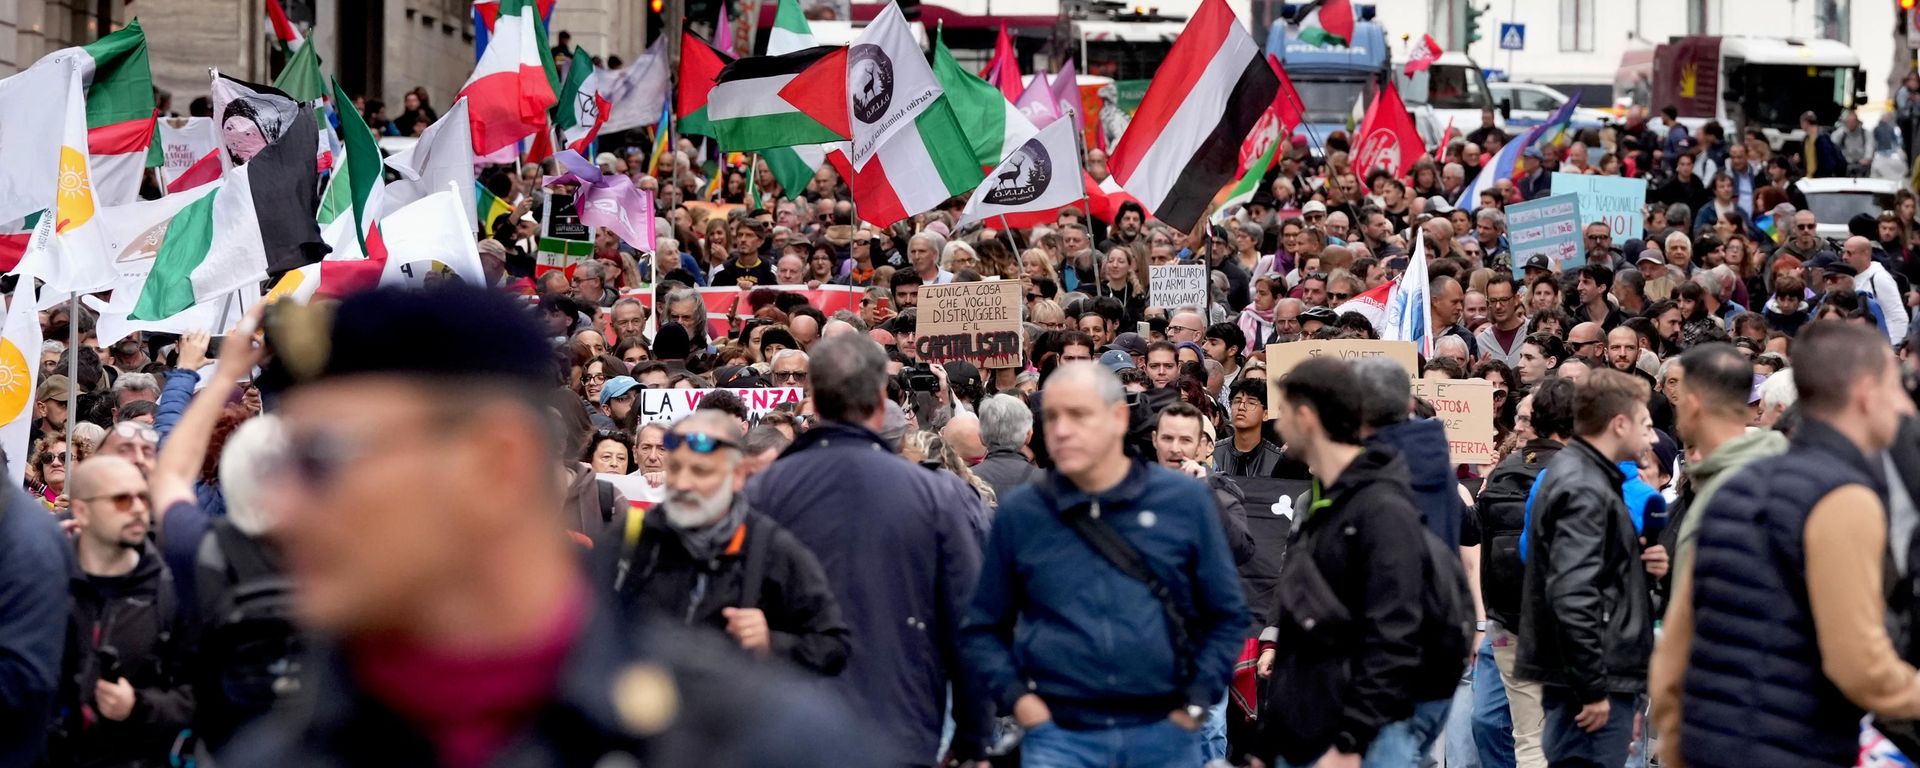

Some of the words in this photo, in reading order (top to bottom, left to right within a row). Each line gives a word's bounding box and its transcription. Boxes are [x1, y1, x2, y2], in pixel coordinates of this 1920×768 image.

[1588, 177, 1600, 193] IL
[1596, 193, 1640, 213] NAZIONALE
[1151, 267, 1167, 279] 20
[1169, 267, 1205, 279] MILIARDI
[926, 285, 971, 299] L'UNICA
[976, 284, 1001, 296] COSA
[1152, 281, 1163, 291] IN
[1165, 279, 1186, 290] ARMI
[1190, 279, 1200, 289] SI
[938, 297, 958, 309] CHE
[964, 296, 1002, 308] VOGLIO
[1153, 289, 1206, 307] MANGIANO?
[933, 306, 1008, 323] DISTRUGGERE
[973, 322, 980, 331] IL
[916, 330, 1020, 360] CAPITALISMO
[643, 391, 673, 415] LA
[1449, 440, 1489, 454] FFERTA
